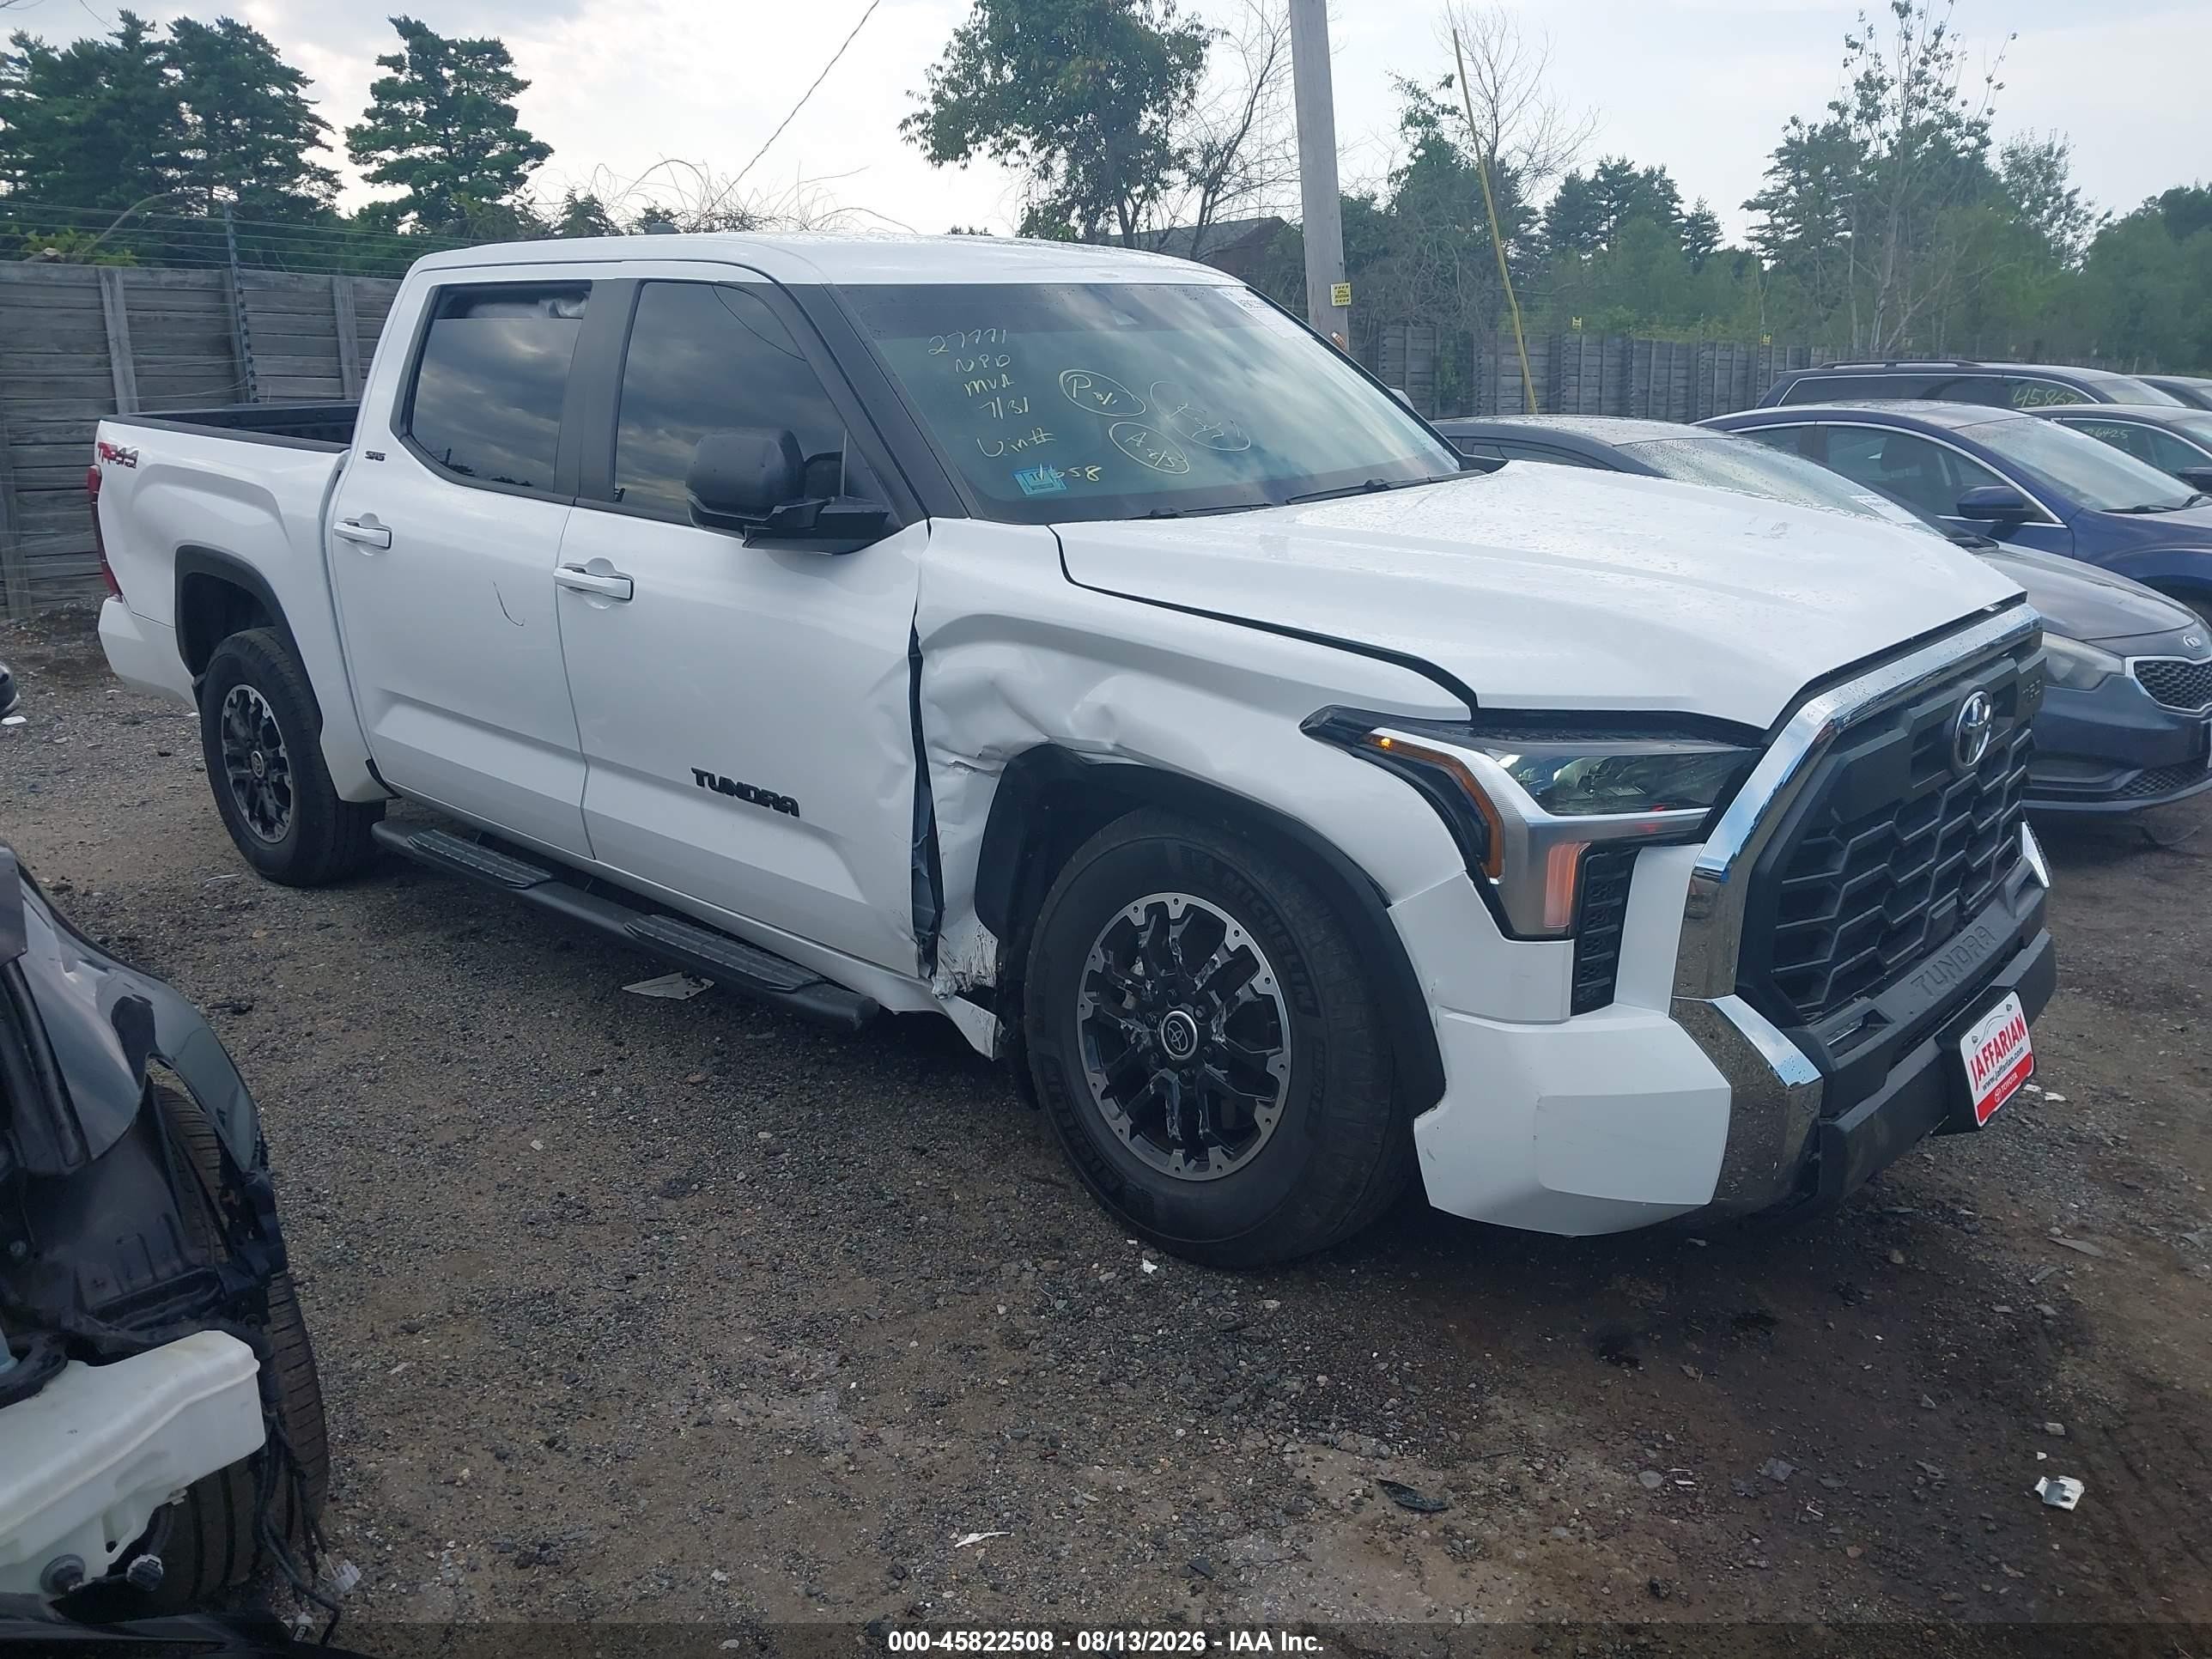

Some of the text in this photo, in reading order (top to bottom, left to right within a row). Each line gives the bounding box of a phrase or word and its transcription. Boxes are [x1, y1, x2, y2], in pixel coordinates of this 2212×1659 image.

[690, 767, 800, 818] TUNDRA
[1910, 926, 1997, 997] TUNDRA
[1970, 1013, 2027, 1091] JAFFARIAN
